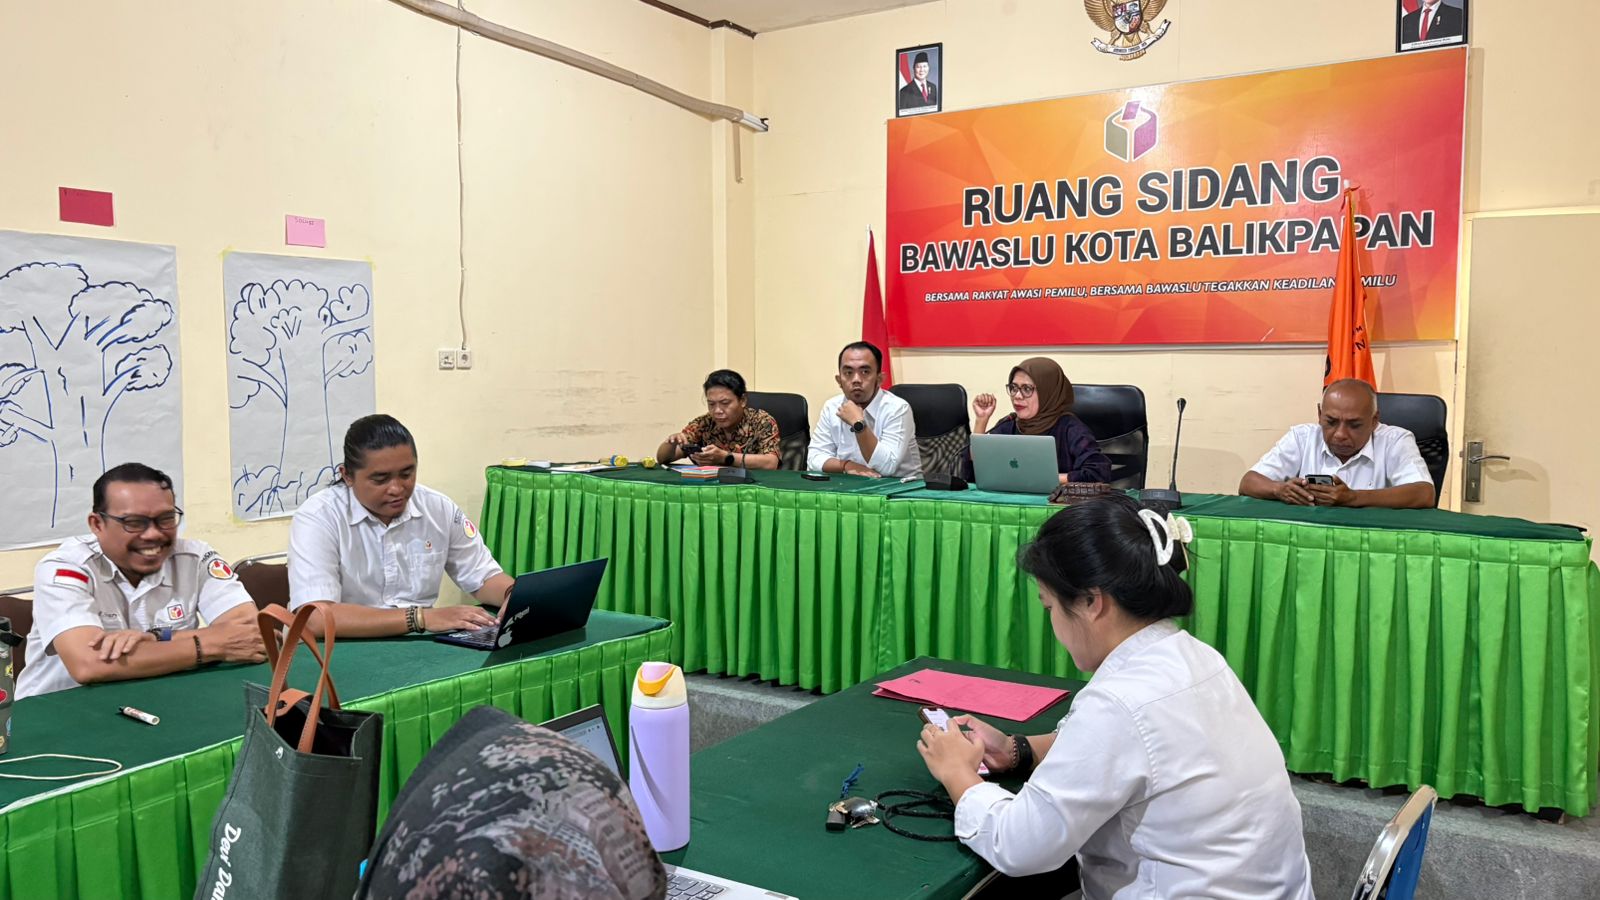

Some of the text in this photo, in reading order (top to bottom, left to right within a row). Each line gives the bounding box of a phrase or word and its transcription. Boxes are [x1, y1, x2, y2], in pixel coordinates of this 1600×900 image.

[963, 156, 1341, 228] RUANG SIDANG
[900, 210, 1435, 274] BAWASLU KOTA BALIKPAPAN
[924, 274, 1398, 303] BERSAMA RAKYAT AWASI PEMILU, BERSAMA BAWASLU TEGAKKAN KEADILAN MILU
